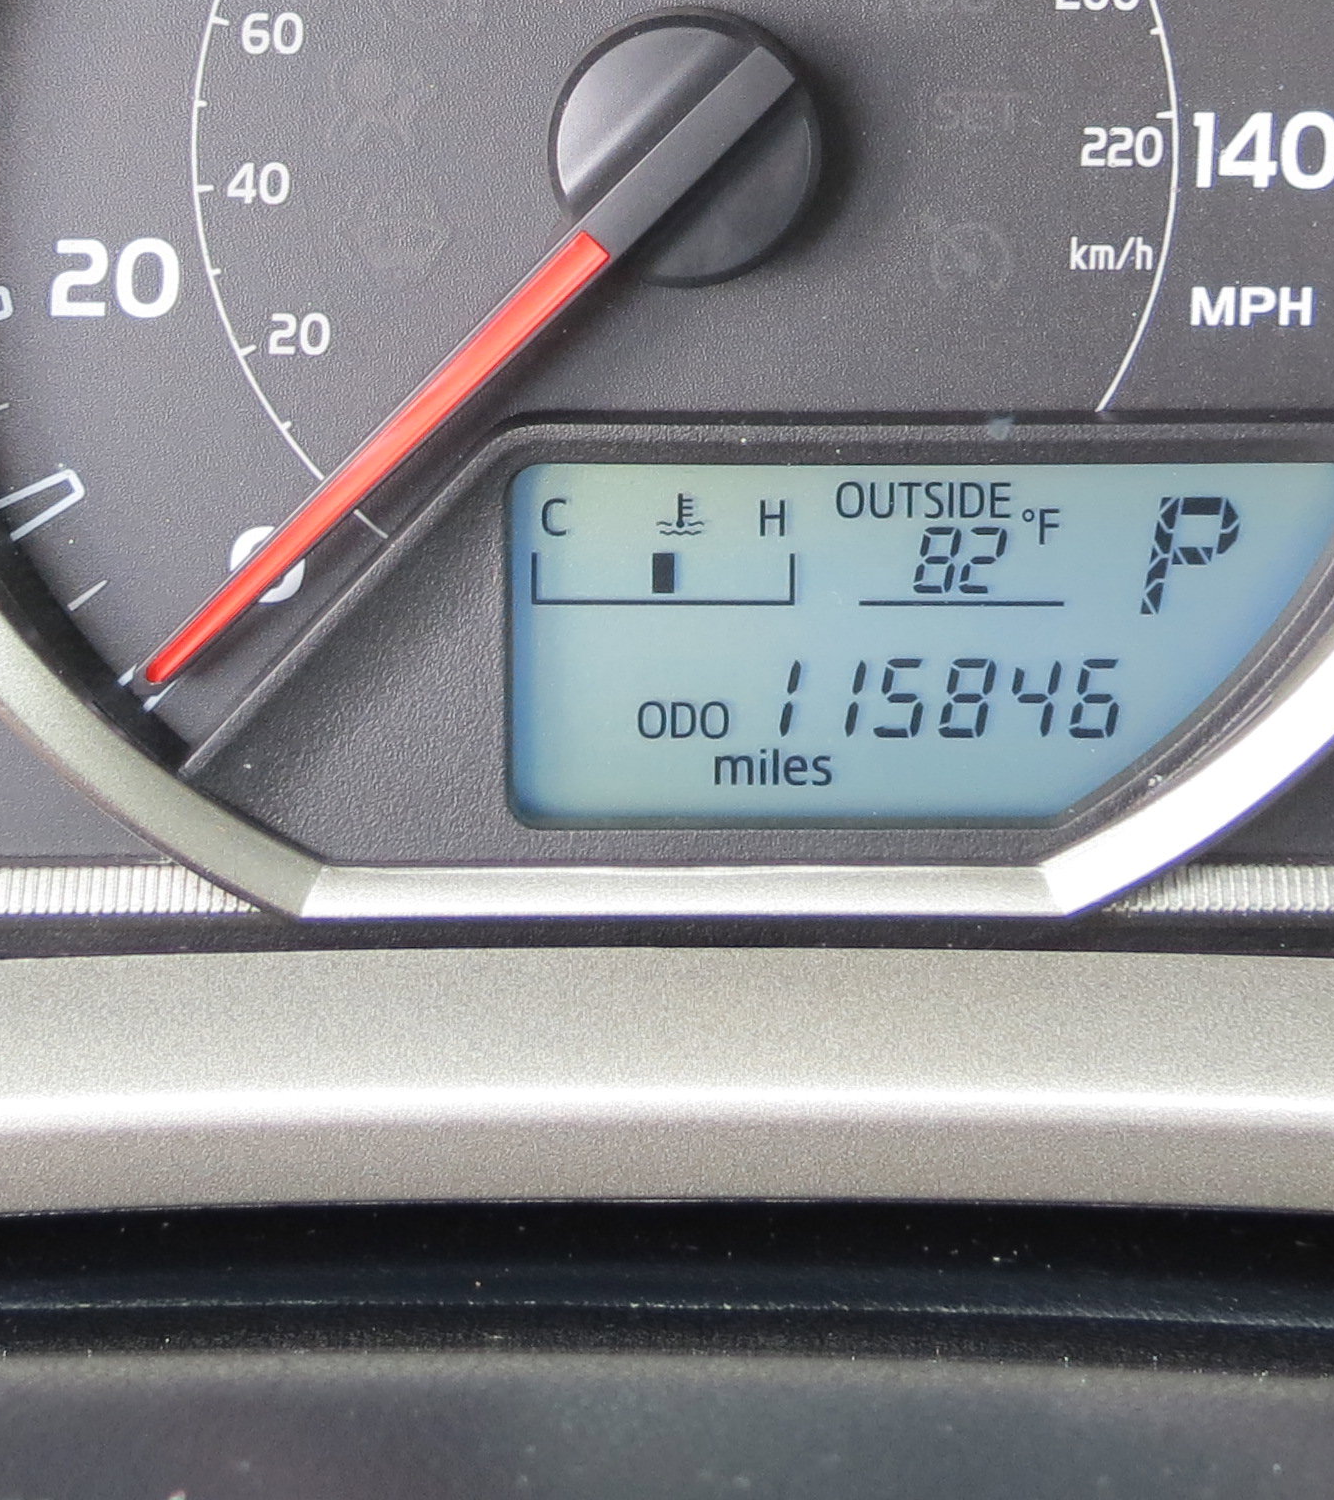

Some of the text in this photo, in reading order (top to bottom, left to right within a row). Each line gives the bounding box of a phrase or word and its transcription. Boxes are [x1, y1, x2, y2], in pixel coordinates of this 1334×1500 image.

[240, 10, 305, 56] 60
[1079, 125, 1165, 169] 220
[225, 160, 291, 206] 40
[1068, 235, 1155, 272] km/h
[49, 236, 181, 320] 20
[1189, 285, 1314, 327] MPH
[267, 311, 332, 357] 20
[539, 496, 568, 538] C
[758, 498, 787, 538] H
[834, 480, 1013, 520] OUTSIDE
[912, 525, 1009, 596] 82
[1139, 495, 1241, 616] P
[636, 657, 1121, 741] ODO 115846
[713, 747, 834, 788] miles
